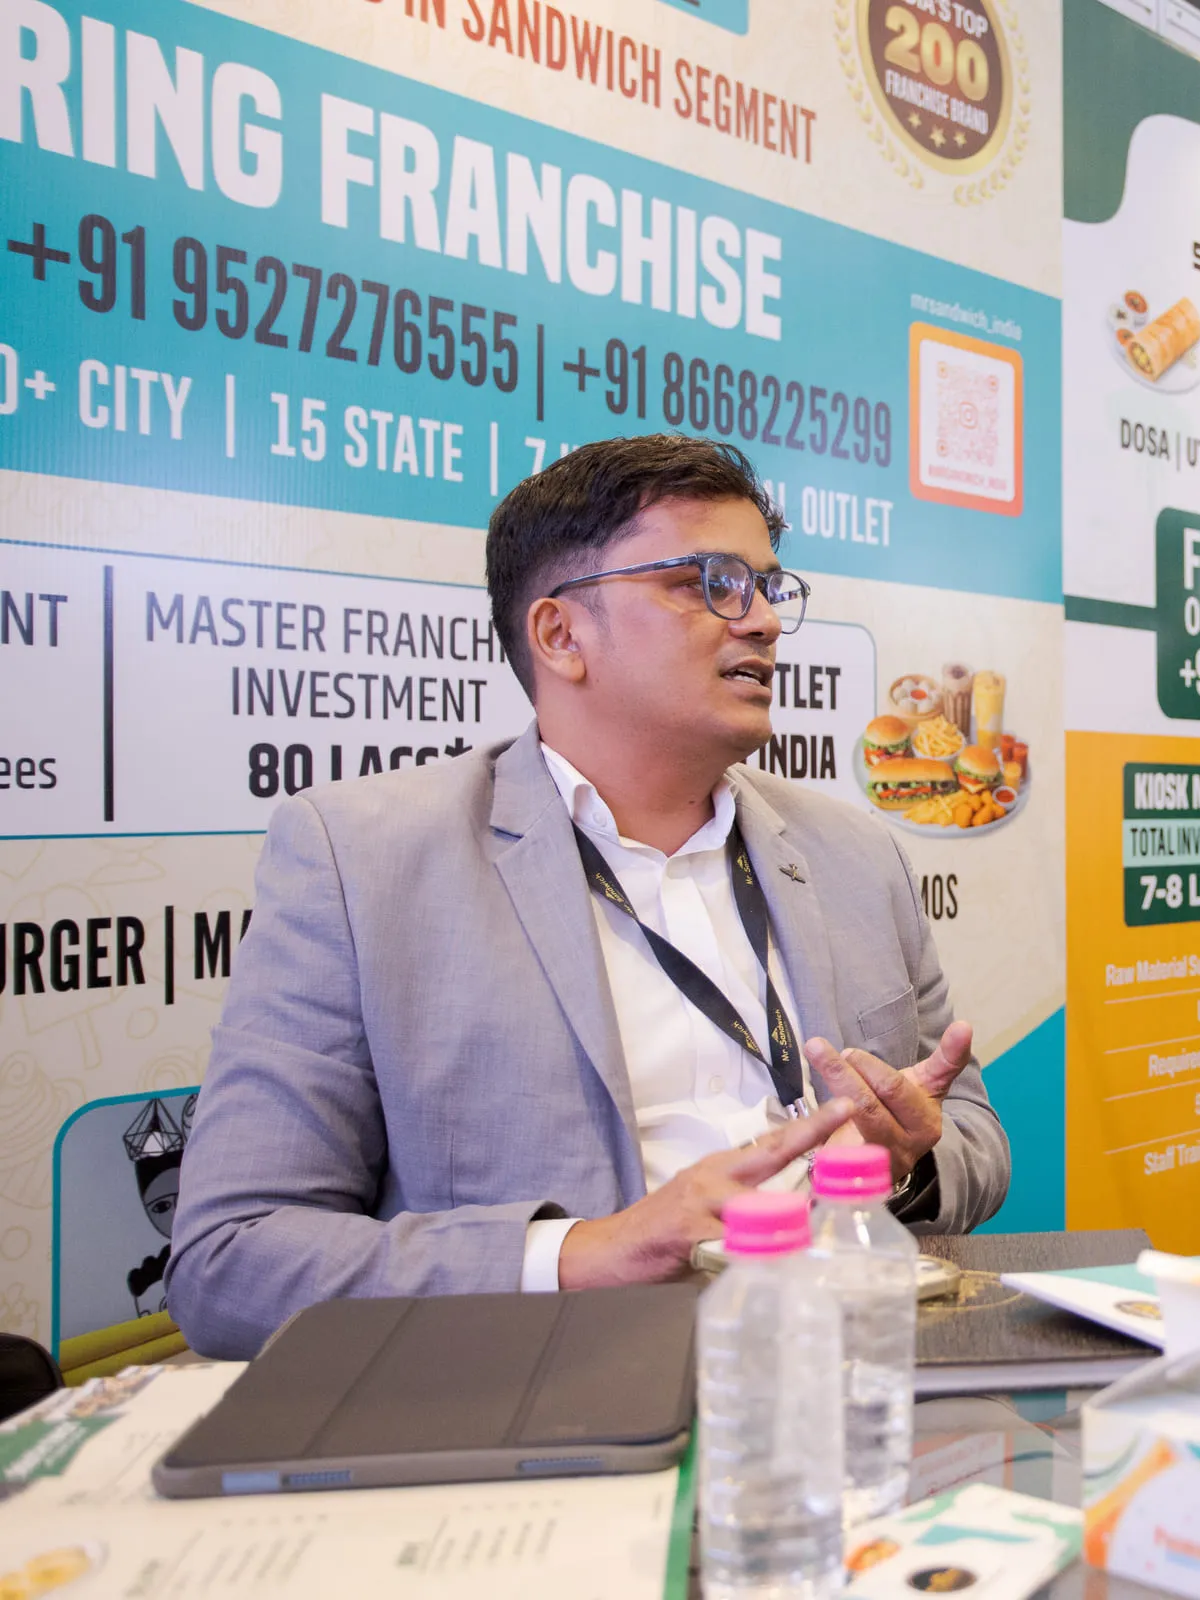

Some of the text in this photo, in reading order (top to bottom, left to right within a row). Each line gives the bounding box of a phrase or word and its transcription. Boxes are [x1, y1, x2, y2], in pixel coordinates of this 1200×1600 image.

[951, 2, 989, 38] TOP
[462, 0, 817, 165] SANDWICH SEGMENT
[884, 5, 990, 101] 200
[885, 68, 989, 135] FRANCHISE BRAND
[321, 92, 782, 341] FRANCHISE
[7, 213, 520, 394] +91 9527276555
[78, 359, 193, 441] CITY
[563, 337, 893, 469] +91 8668225299
[270, 392, 465, 483] 15 STATE
[1119, 418, 1170, 462] DOSA
[801, 485, 895, 548] OUTLET
[145, 591, 327, 653] MASTER
[231, 666, 488, 723] INVESTMENT
[248, 742, 313, 799] 80
[759, 732, 837, 780] INDIA
[1134, 772, 1190, 811] KIOSK
[1140, 873, 1184, 911] 7-8
[0, 916, 146, 995] RGER
[1105, 963, 1135, 988] Raw
[1136, 955, 1187, 983] Material
[775, 1009, 788, 1046] Sandwich
[1144, 1144, 1175, 1175] Staff
